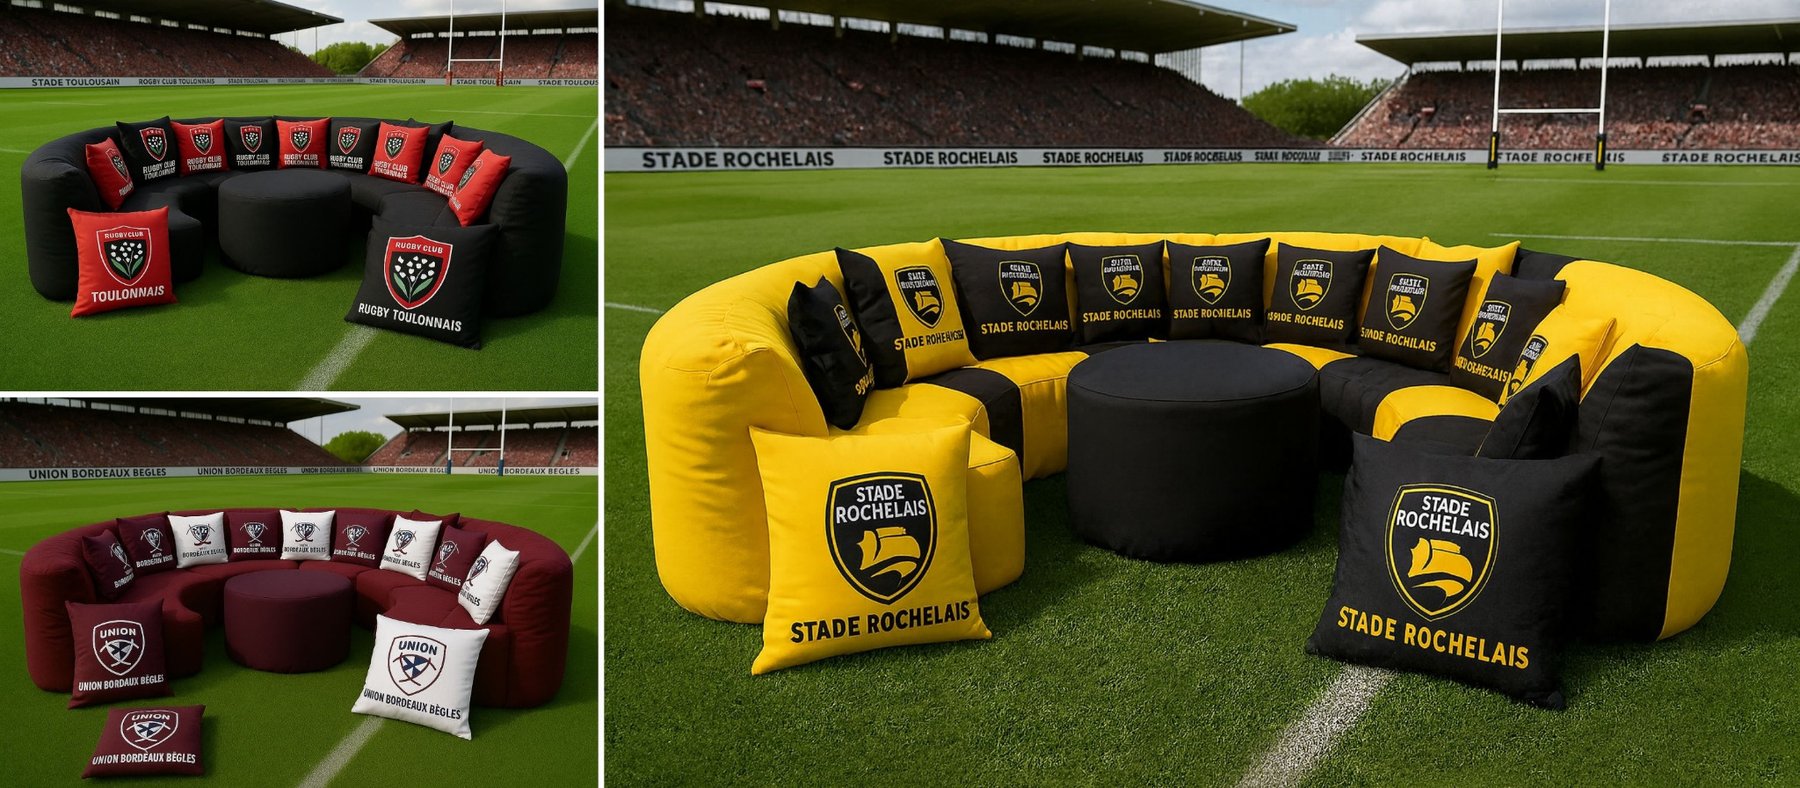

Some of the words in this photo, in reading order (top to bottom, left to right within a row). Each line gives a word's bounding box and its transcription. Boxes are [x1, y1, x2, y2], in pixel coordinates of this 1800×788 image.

[31, 78, 63, 87] STADE
[66, 78, 120, 86] TOULOUSAIN
[207, 155, 222, 163] CLUB
[642, 151, 719, 169] STADE
[723, 151, 835, 168] ROCHELAIS
[883, 151, 935, 165] STADE
[938, 151, 1018, 165] ROCHELAIS
[1043, 151, 1082, 164] STADE
[1084, 151, 1144, 164] ROCHELAIS
[1361, 151, 1398, 162] STADE
[1661, 152, 1709, 163] STADE
[1713, 152, 1800, 163] ROCHELAIS
[392, 162, 408, 172] CLUB
[395, 241, 421, 250] RUGBY
[422, 244, 443, 254] CLUB
[91, 285, 165, 302] TOULONNAIS
[358, 302, 390, 319] RUGBY
[392, 308, 462, 332] TOULONNAIS
[1082, 310, 1111, 323] STADE
[1113, 308, 1161, 320] ROCHELAIS
[1173, 308, 1199, 319] STADE
[981, 321, 1014, 335] STADE
[1016, 319, 1069, 332] ROCHELAIS
[1294, 312, 1344, 331] ROCHELAIS
[28, 469, 68, 479] UNION
[72, 468, 130, 478] BORDEAUX
[132, 467, 167, 477] BEGLES
[197, 467, 223, 475] UNION
[225, 467, 264, 475] BORDEAUX
[504, 467, 546, 475] BORDEAUX
[548, 467, 580, 475] BEGLES
[856, 483, 905, 503] STADE
[836, 499, 927, 524] ROCHELAIS
[1421, 495, 1471, 517] STADE
[1396, 509, 1490, 540] ROCHELAIS
[790, 615, 861, 643] STADE
[867, 600, 970, 634] ROCHELAIS
[100, 627, 136, 639] UNION
[1337, 605, 1398, 641] STADE
[1404, 622, 1529, 670] ROCHELAIS
[398, 640, 438, 656] UNION
[78, 681, 102, 691] UNION
[103, 677, 139, 690] BORDAUX
[363, 687, 385, 703] UNION
[385, 694, 428, 713] BORDEAUX
[429, 703, 461, 720] BÈGLES
[131, 713, 170, 721] UNION
[92, 753, 119, 765] UNION
[120, 752, 164, 763] BORDEAUX
